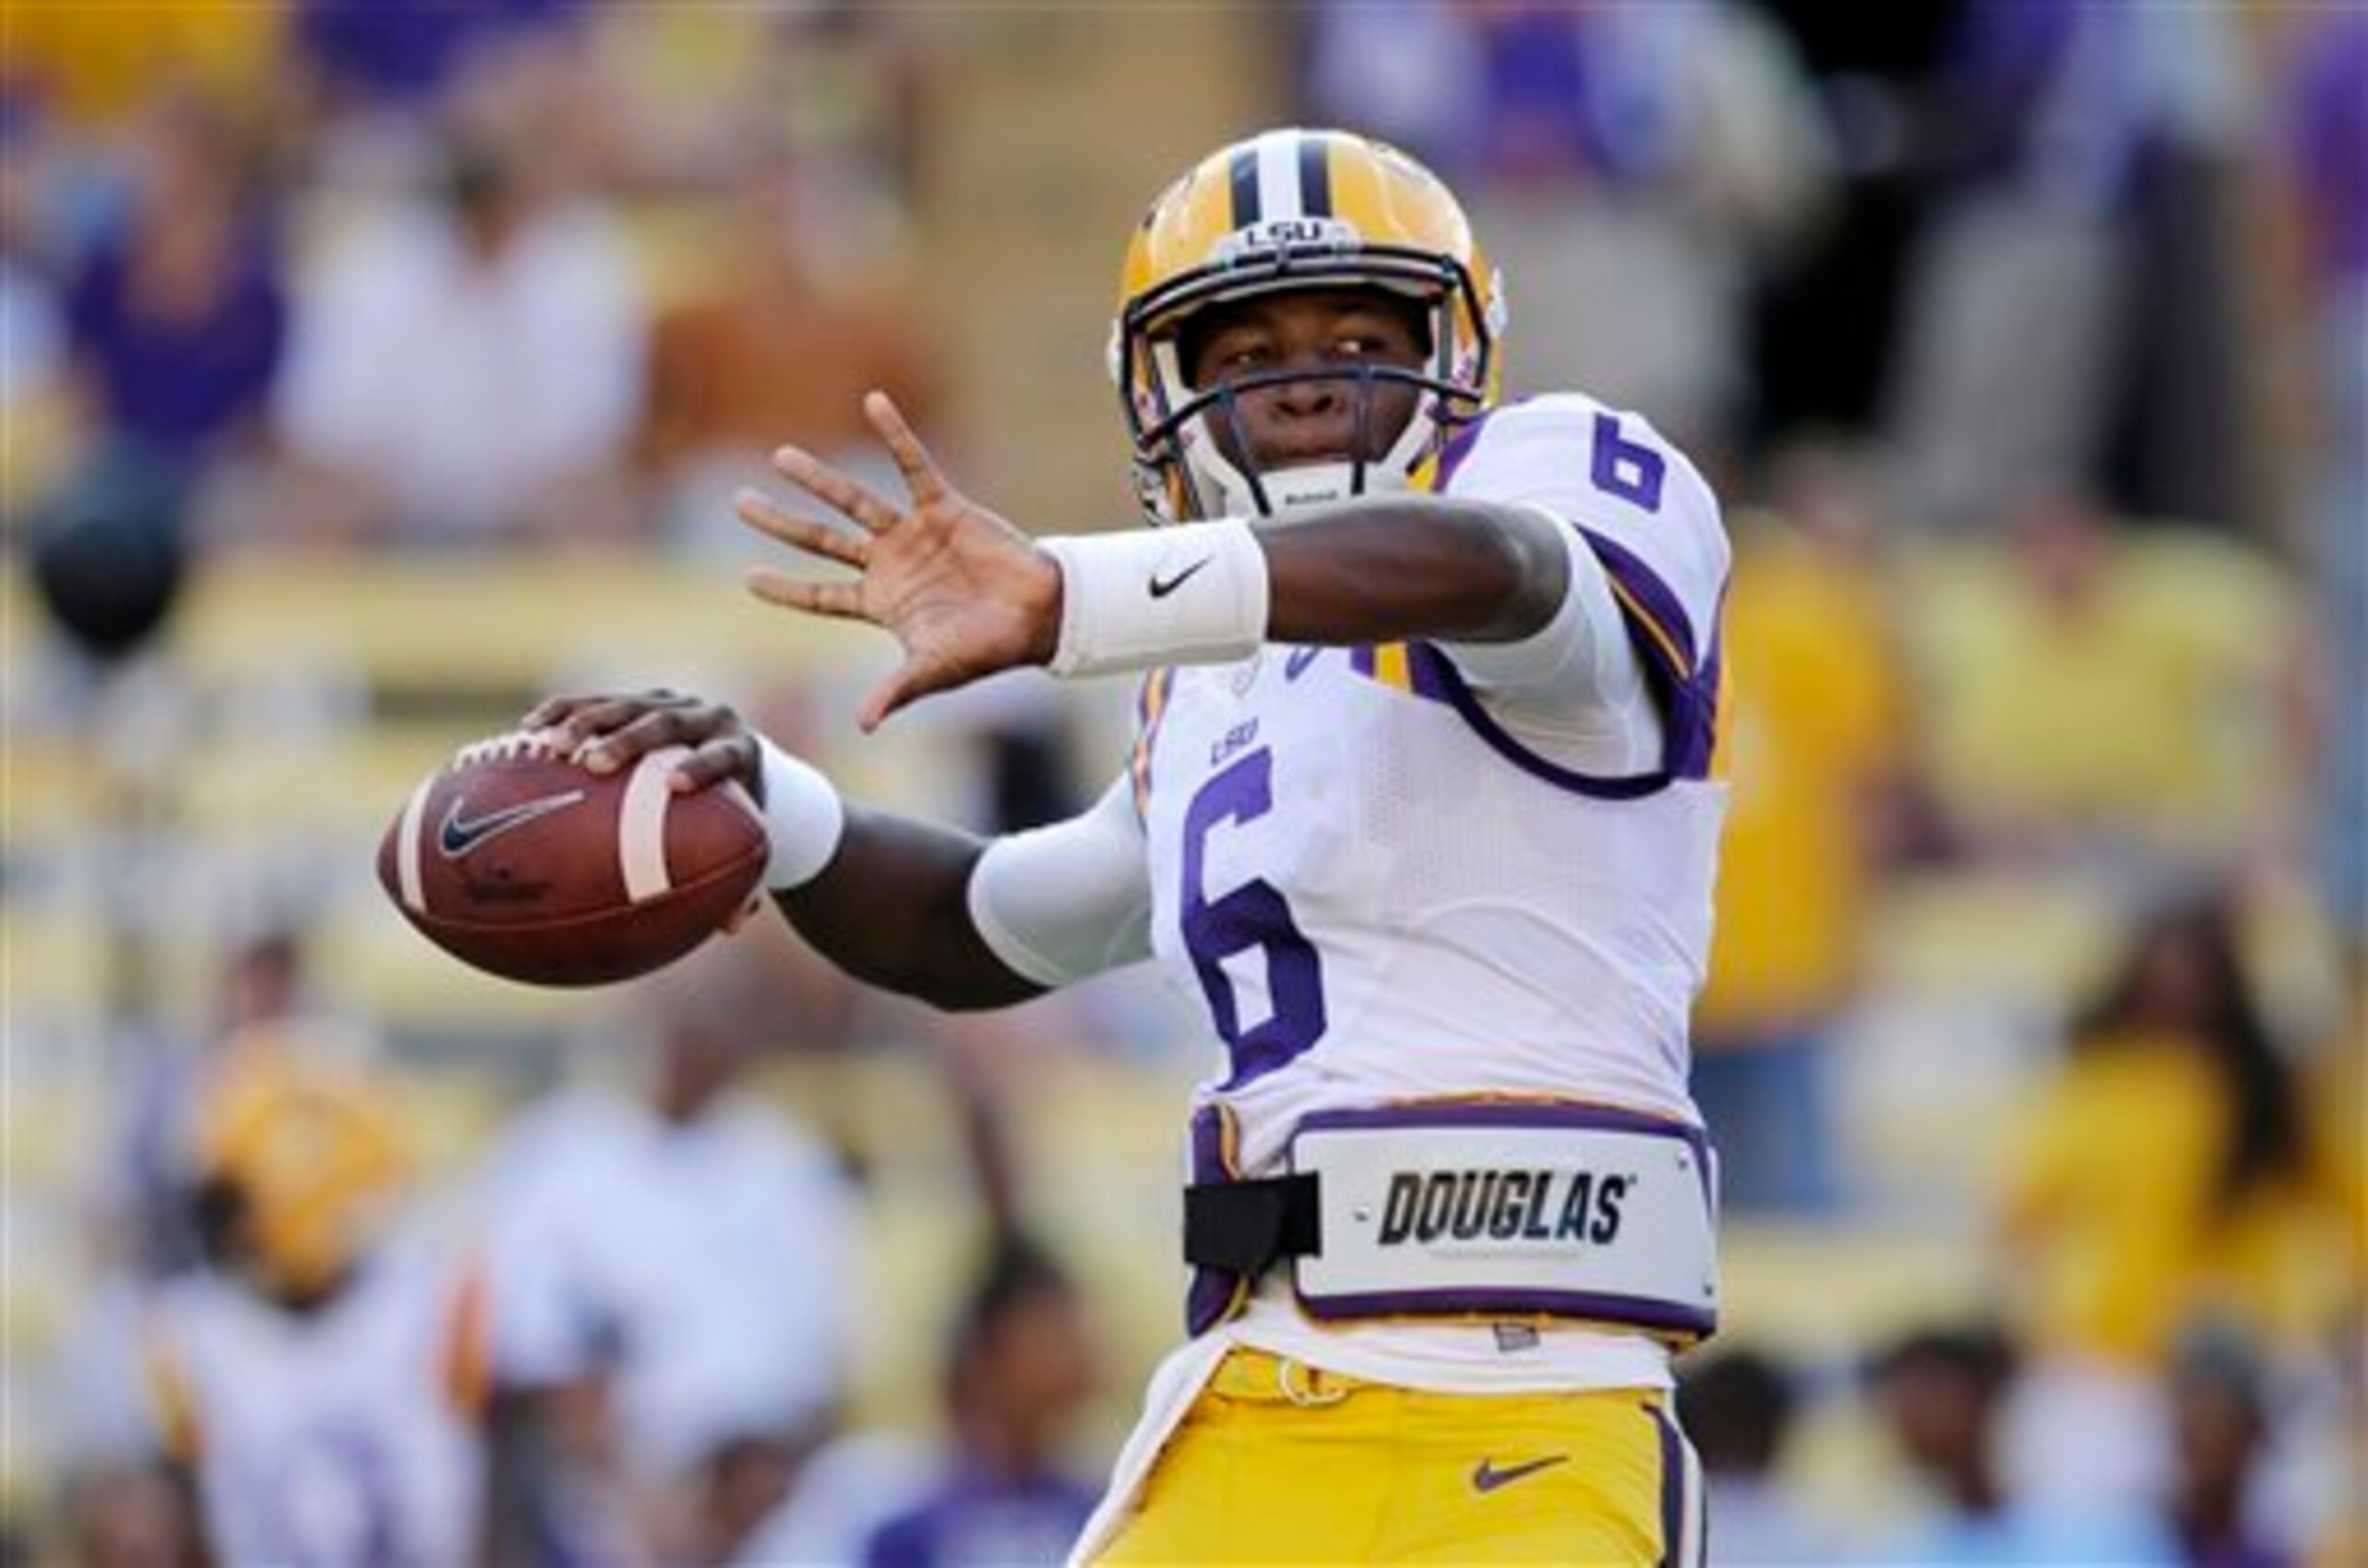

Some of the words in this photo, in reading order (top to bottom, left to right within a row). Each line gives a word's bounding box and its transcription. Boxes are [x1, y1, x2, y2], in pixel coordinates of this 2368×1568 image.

[1247, 221, 1322, 247] LSU
[1592, 412, 1665, 513] 6
[1211, 716, 1259, 767] LSU
[1180, 744, 1327, 1092] 6
[1378, 1171, 1626, 1245] DOUGLAS
